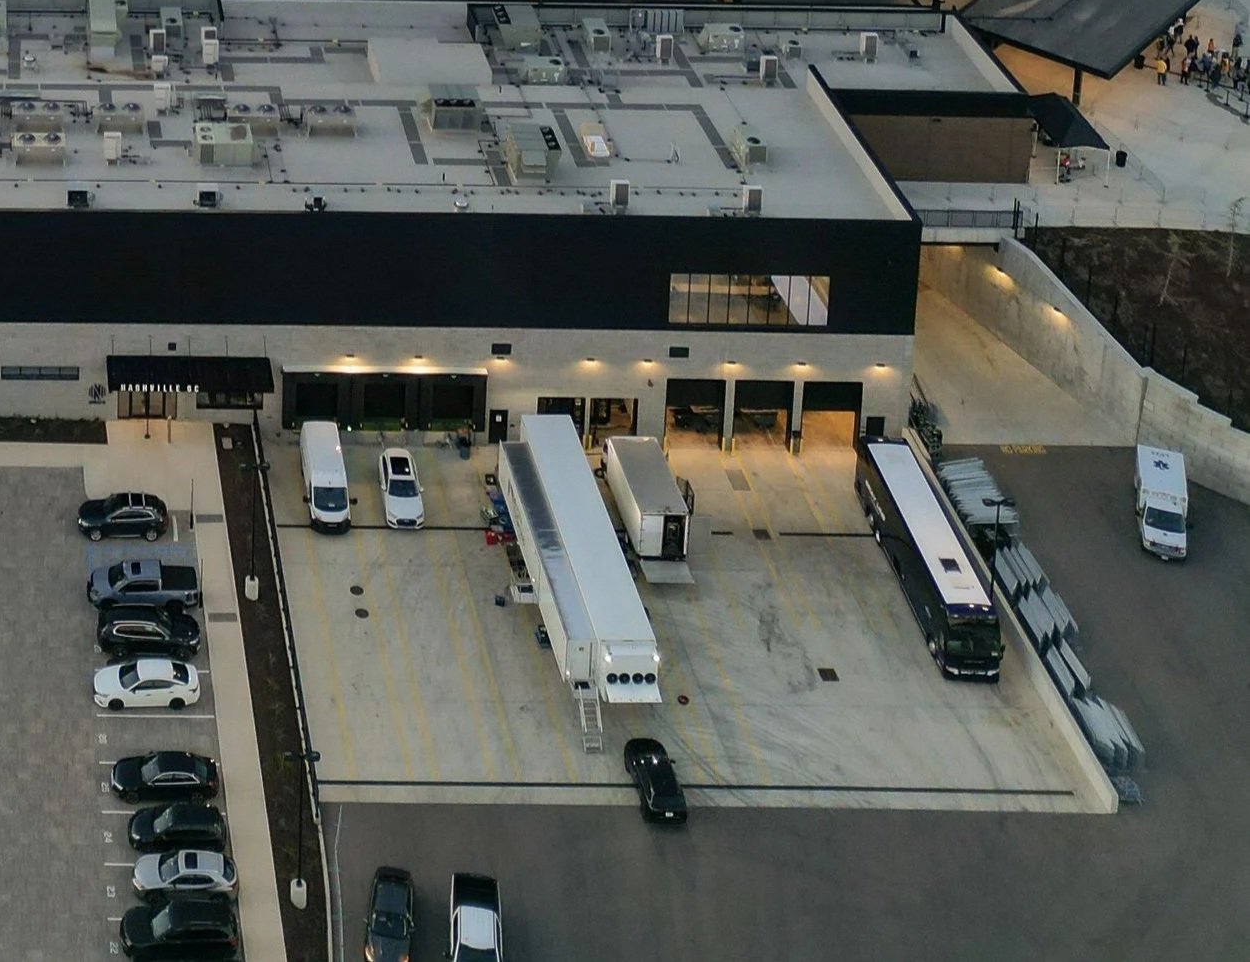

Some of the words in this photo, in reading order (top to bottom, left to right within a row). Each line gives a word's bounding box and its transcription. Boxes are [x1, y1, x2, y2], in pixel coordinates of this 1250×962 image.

[120, 384, 180, 393] NASHVILLE
[101, 782, 110, 793] 25
[103, 831, 113, 843] 24
[106, 885, 116, 898] 23
[109, 941, 119, 955] 22
